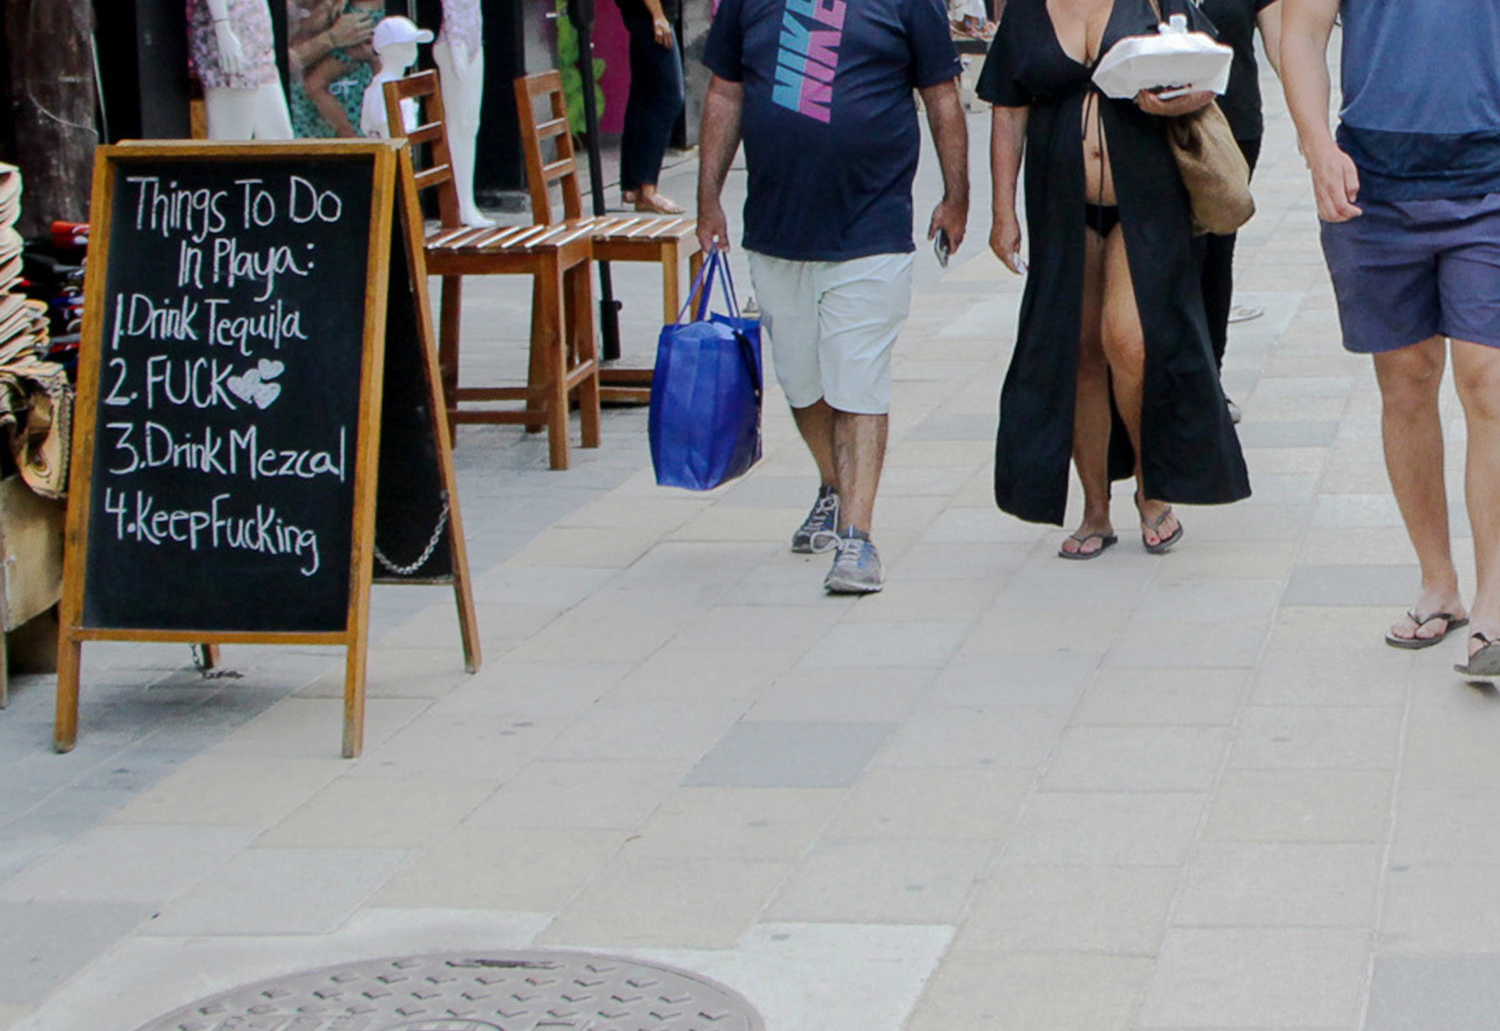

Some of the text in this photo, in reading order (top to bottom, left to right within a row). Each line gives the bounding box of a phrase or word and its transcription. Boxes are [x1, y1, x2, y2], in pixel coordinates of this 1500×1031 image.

[126, 175, 343, 244] Things To Do
[177, 239, 204, 290] In
[203, 297, 309, 357] Tequila
[146, 354, 237, 411] FUCK
[229, 424, 346, 483] Mezcal
